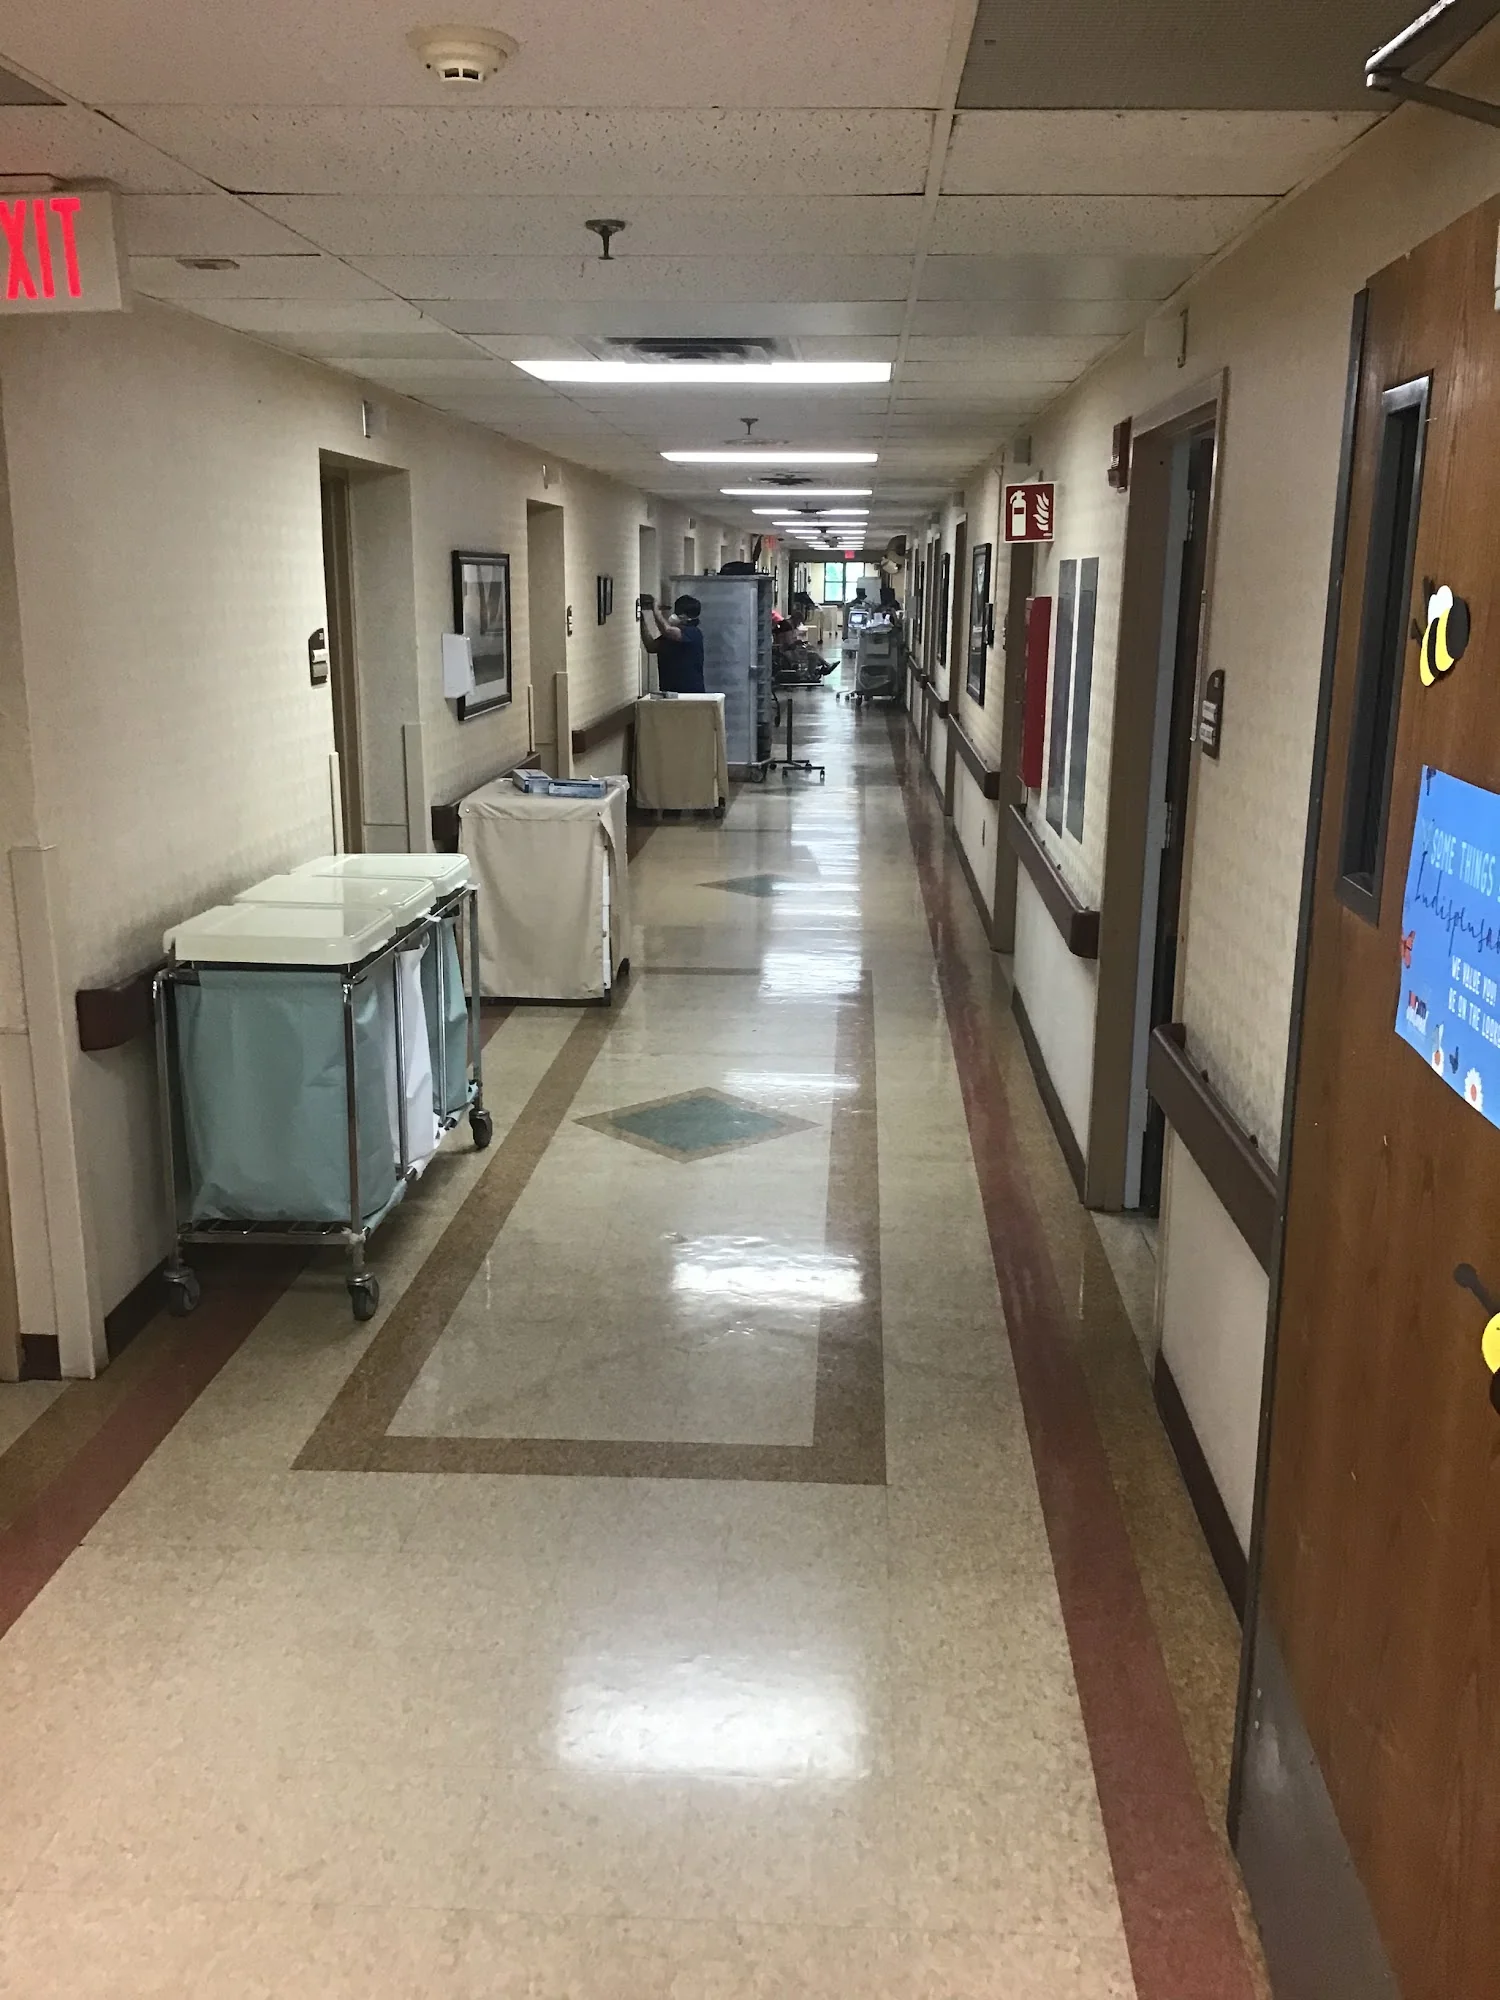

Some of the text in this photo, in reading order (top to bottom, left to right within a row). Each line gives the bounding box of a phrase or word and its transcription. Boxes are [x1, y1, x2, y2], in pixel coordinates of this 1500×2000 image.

[1431, 828, 1496, 897] SOME THINGS
[1452, 955, 1462, 980] WE
[1463, 962, 1481, 995] VALUE
[1448, 987, 1457, 1013] BE
[1458, 995, 1468, 1020] ON
[1469, 1002, 1481, 1031] THE
